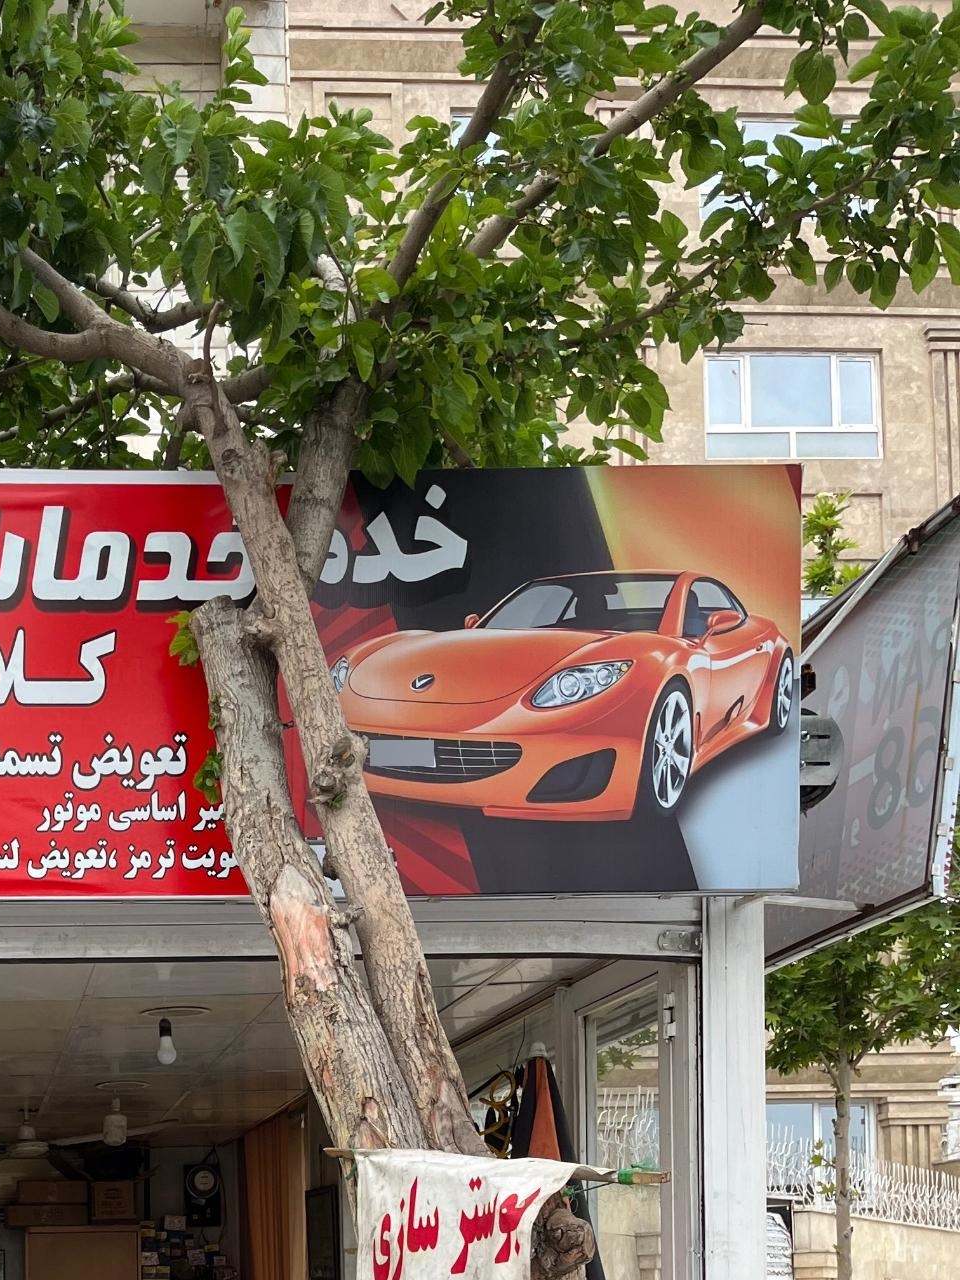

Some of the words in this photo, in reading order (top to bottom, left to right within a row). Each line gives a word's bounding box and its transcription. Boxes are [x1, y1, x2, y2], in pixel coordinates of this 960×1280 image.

[318, 484, 468, 584] خدم
[71, 733, 188, 791] تعویض
[35, 791, 103, 833] موتور
[107, 790, 187, 832] اساسی
[122, 838, 176, 880] ترمز
